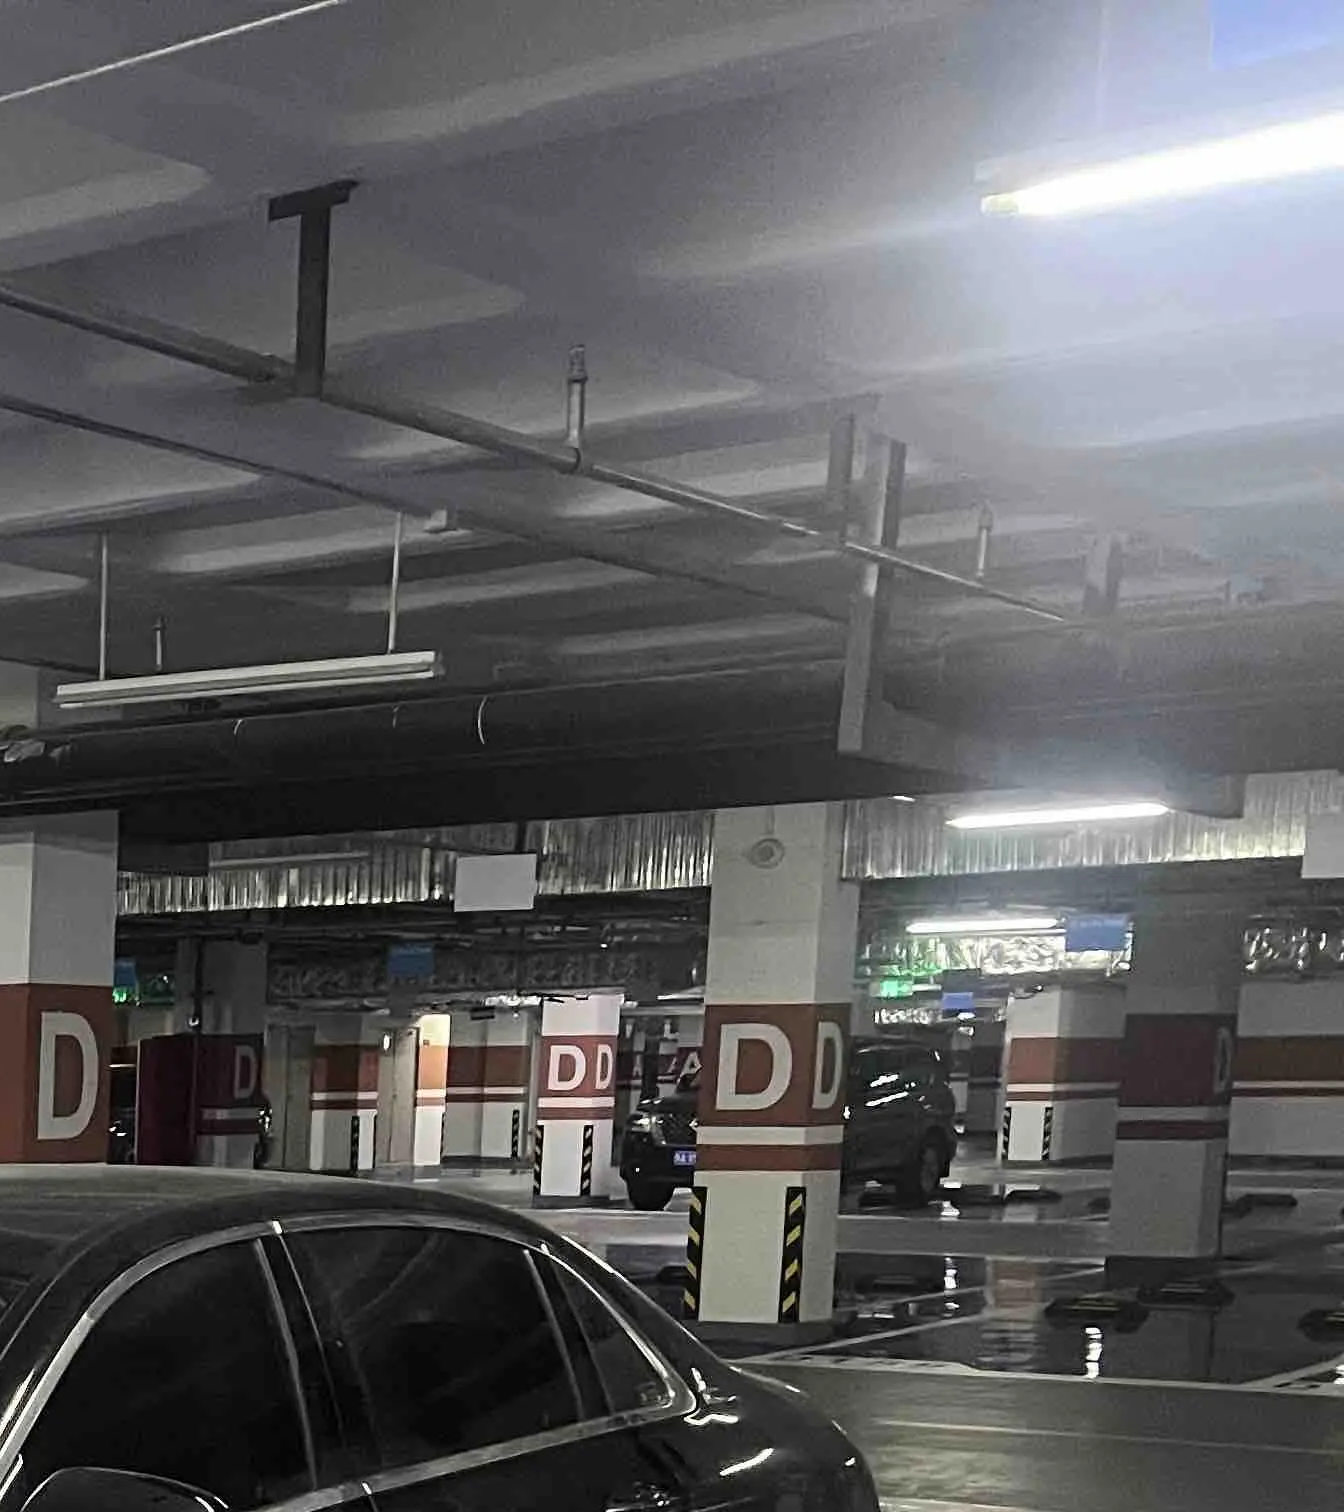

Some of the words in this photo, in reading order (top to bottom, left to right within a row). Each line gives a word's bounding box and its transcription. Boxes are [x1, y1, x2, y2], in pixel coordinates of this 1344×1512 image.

[38, 1012, 99, 1140] D
[234, 1045, 258, 1099] D
[547, 1043, 586, 1091] D
[595, 1043, 614, 1090] D
[716, 1023, 792, 1110] D
[812, 1022, 843, 1110] D
